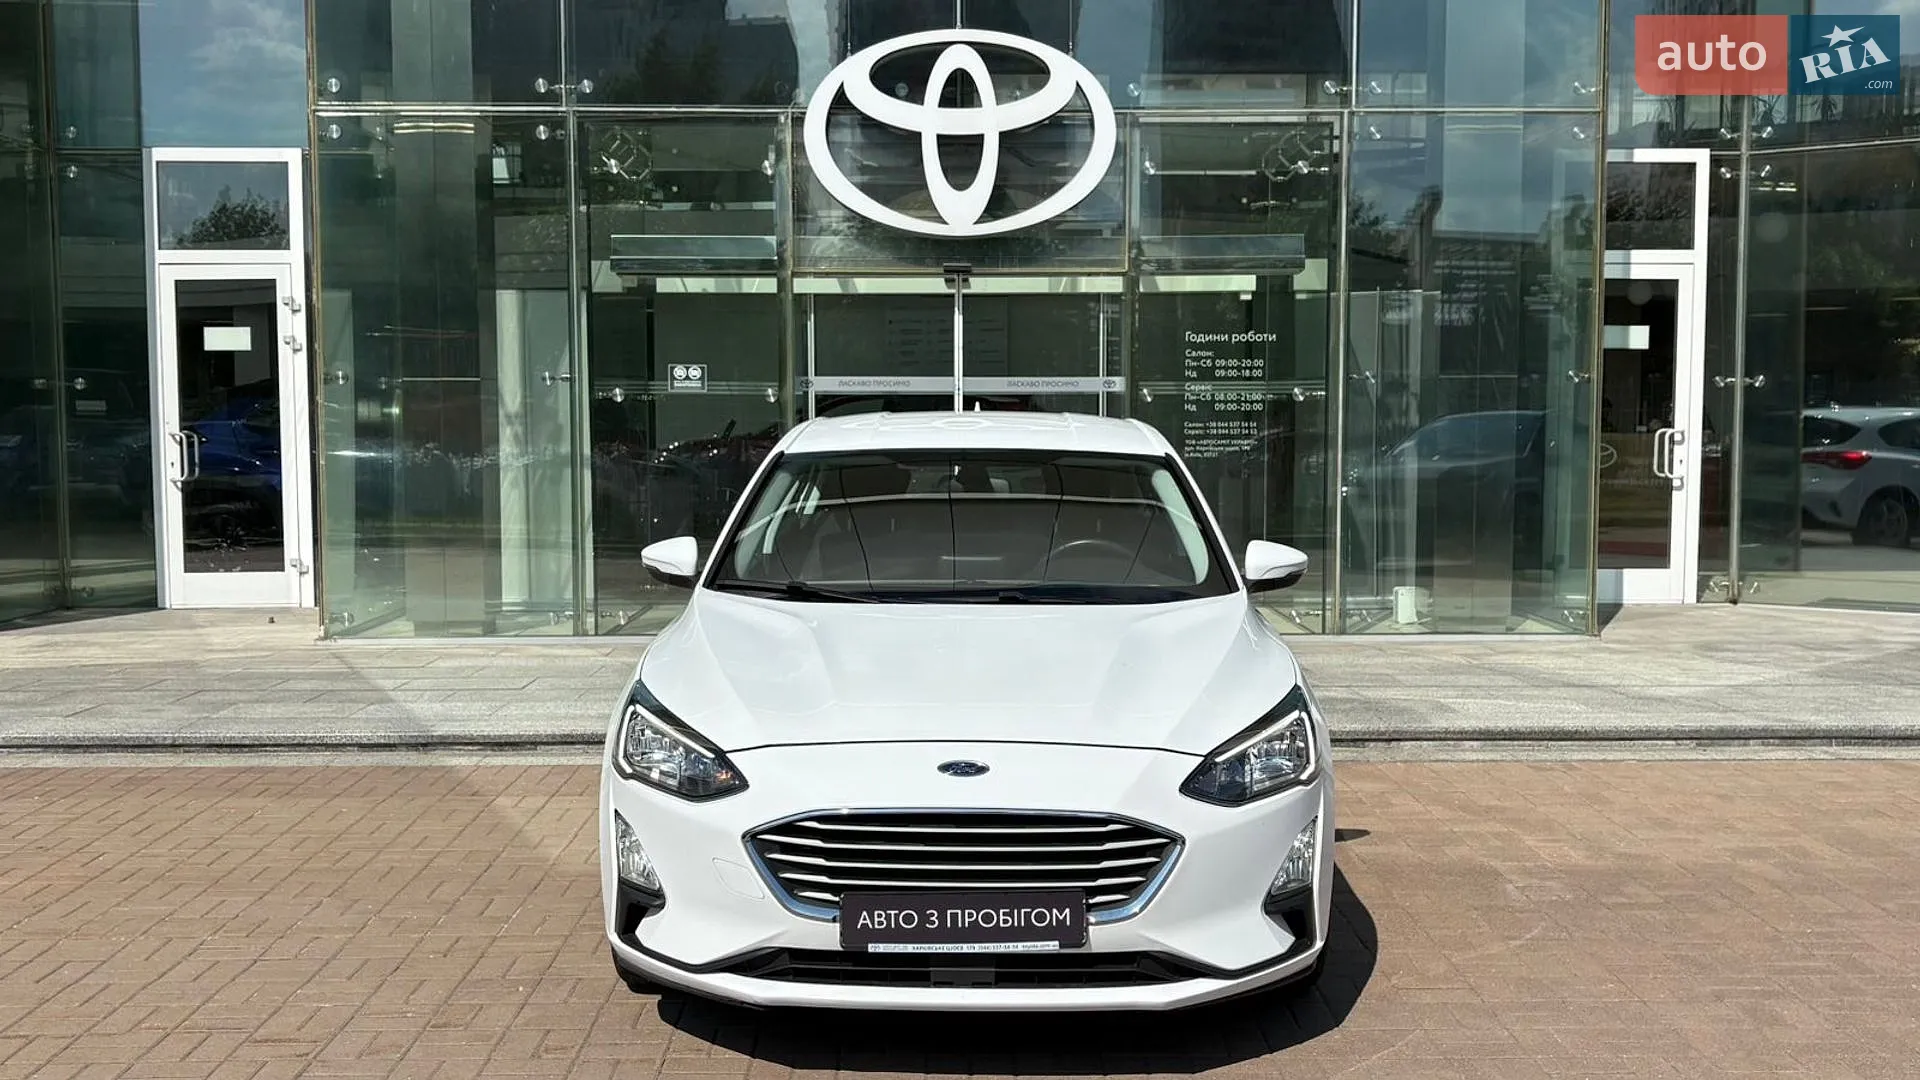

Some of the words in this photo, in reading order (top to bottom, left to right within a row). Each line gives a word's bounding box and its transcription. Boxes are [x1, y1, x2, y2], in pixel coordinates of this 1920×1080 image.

[1185, 331, 1229, 344] Години
[1231, 330, 1277, 344] роботи
[1185, 348, 1215, 357] Салон:
[1184, 359, 1213, 367] Пн-Сб
[1214, 359, 1264, 367] 09:00-20:00
[1184, 369, 1198, 378] Нд
[1214, 369, 1263, 377] 09:00-18:00
[872, 379, 912, 388] ПРОСИМО
[1041, 380, 1080, 388] ПРОСИМО
[1184, 403, 1198, 411] Нд
[1214, 403, 1264, 411] 09:00-20:00
[857, 909, 919, 929] АВТО
[946, 907, 1071, 929] ПРОБІГОМ
